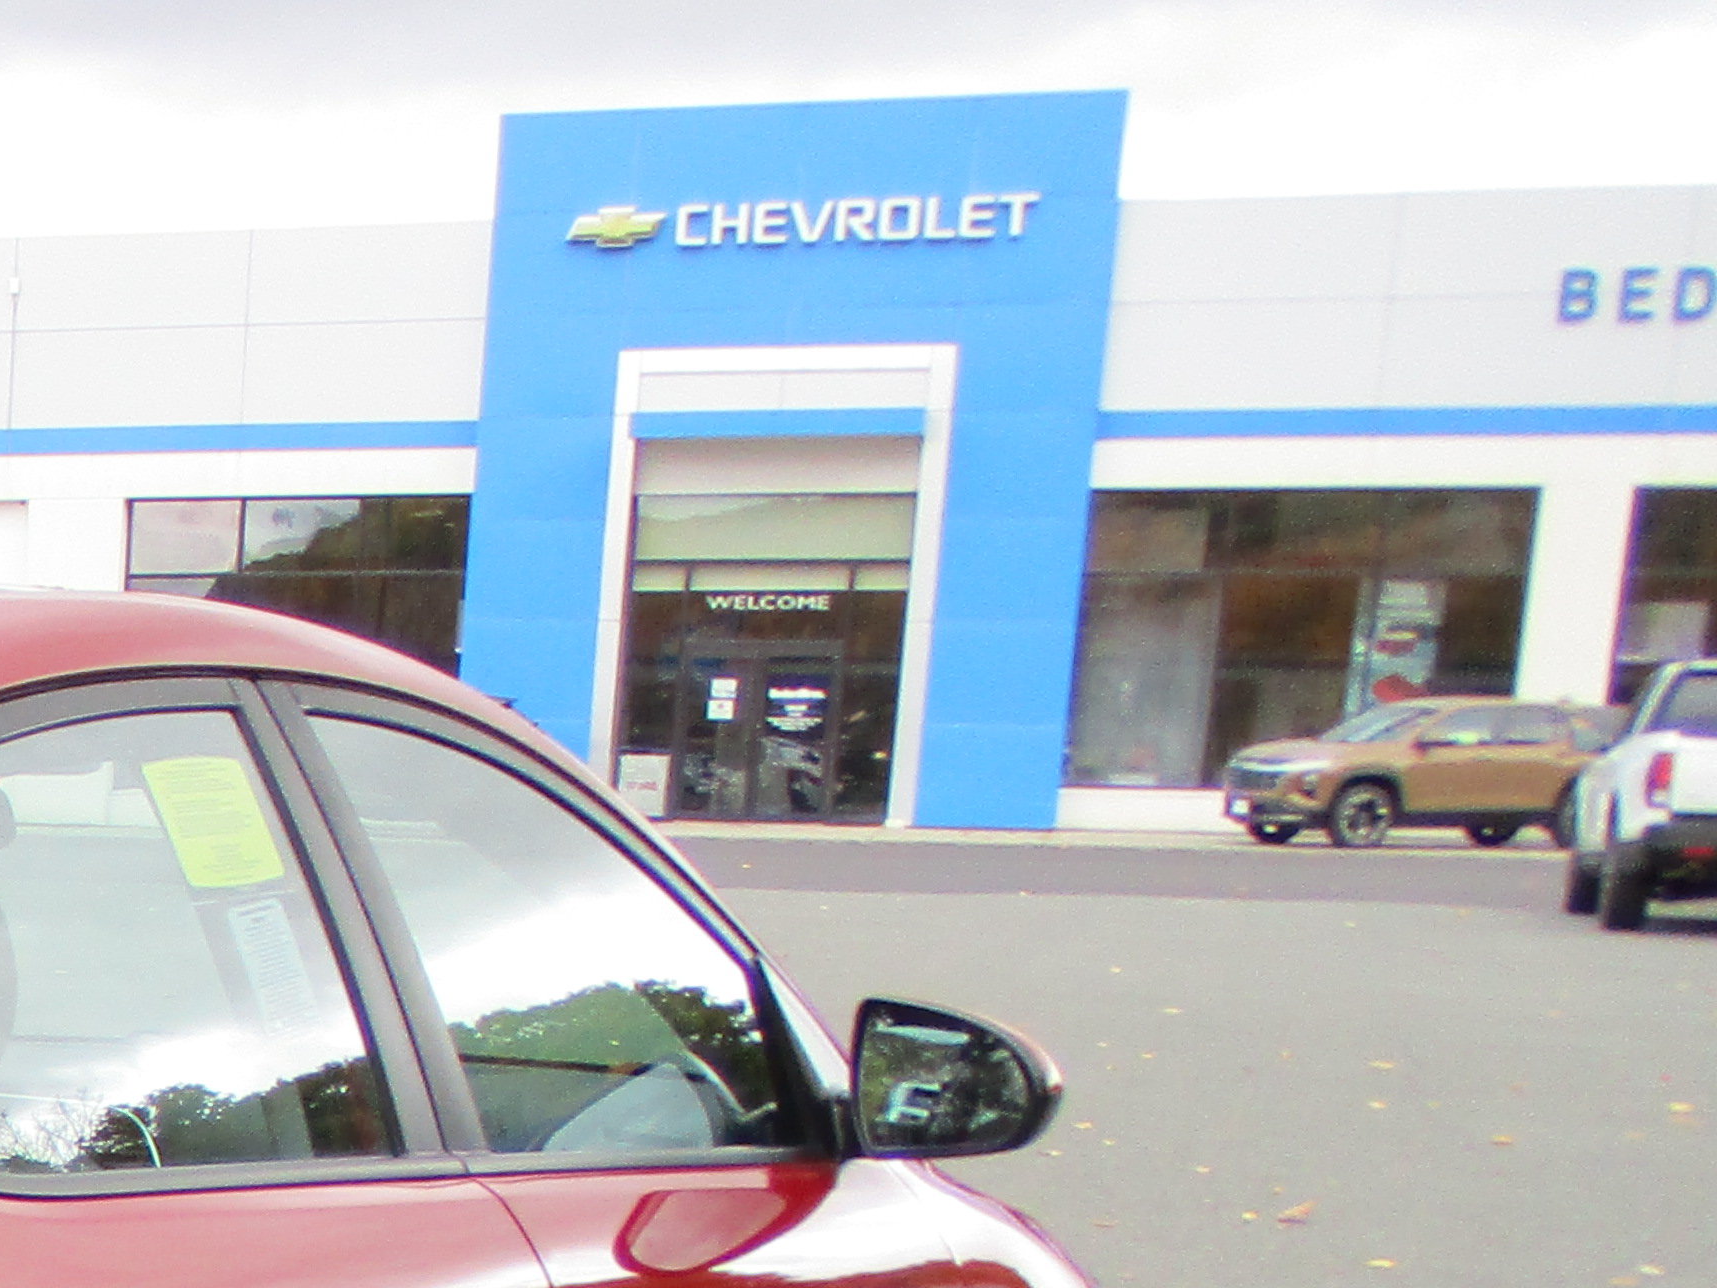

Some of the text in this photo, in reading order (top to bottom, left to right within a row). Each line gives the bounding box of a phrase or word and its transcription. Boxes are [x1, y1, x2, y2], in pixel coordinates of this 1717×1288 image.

[675, 192, 1042, 246] CHEVROLET
[1557, 267, 1717, 322] BED
[706, 595, 831, 611] WELCOME
